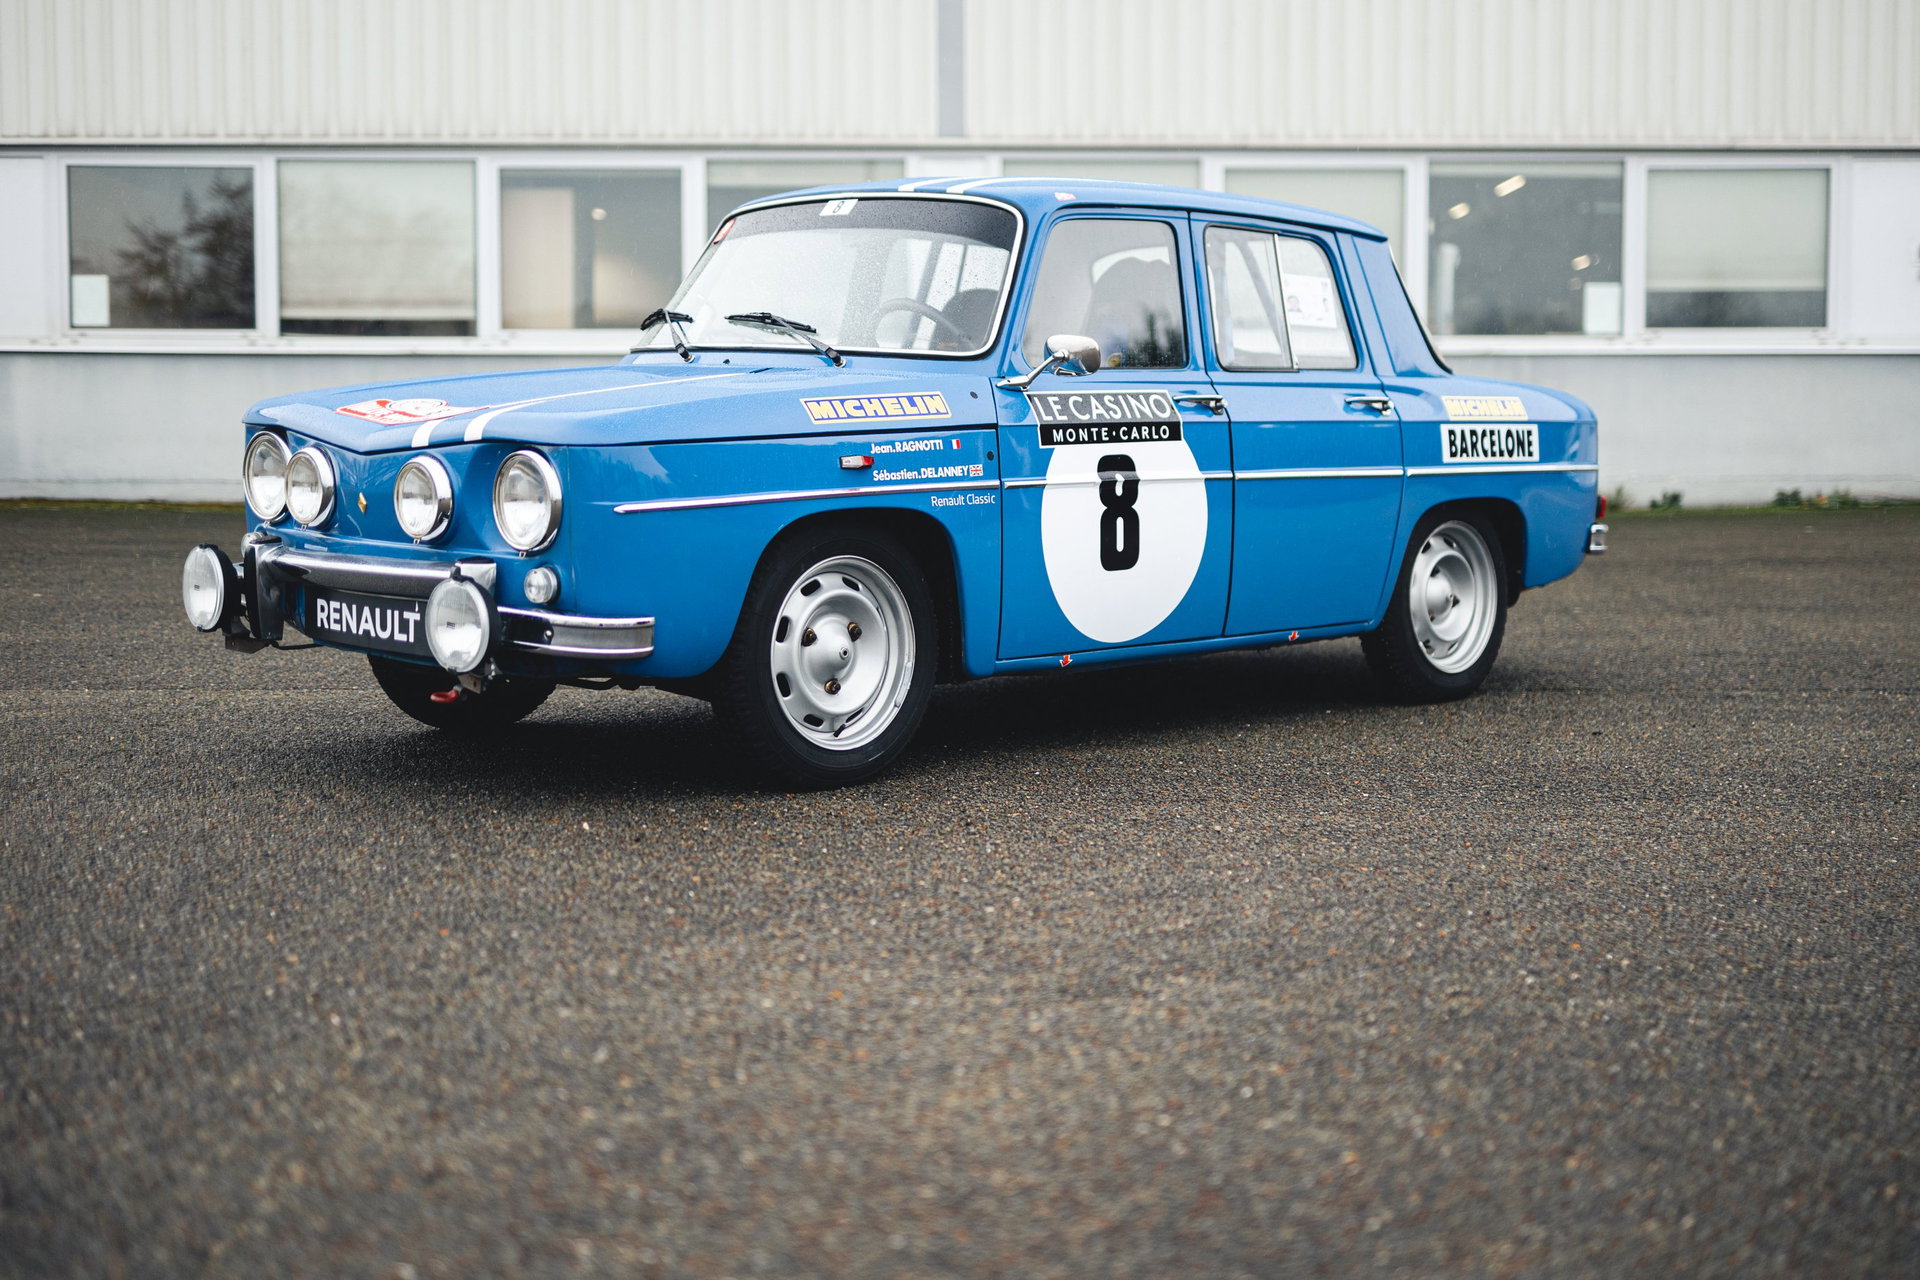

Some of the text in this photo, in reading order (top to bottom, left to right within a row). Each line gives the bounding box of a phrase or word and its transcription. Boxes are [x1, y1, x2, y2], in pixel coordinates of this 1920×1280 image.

[832, 201, 845, 213] 8
[806, 394, 948, 420] MICHELIN
[1034, 394, 1171, 421] LE CASINO
[870, 439, 944, 454] Jean.RAGNOTTI
[1448, 429, 1534, 458] BARCELONE
[931, 493, 996, 507] Renault Classic
[1097, 454, 1140, 571] 8
[316, 598, 421, 643] RENAULT
